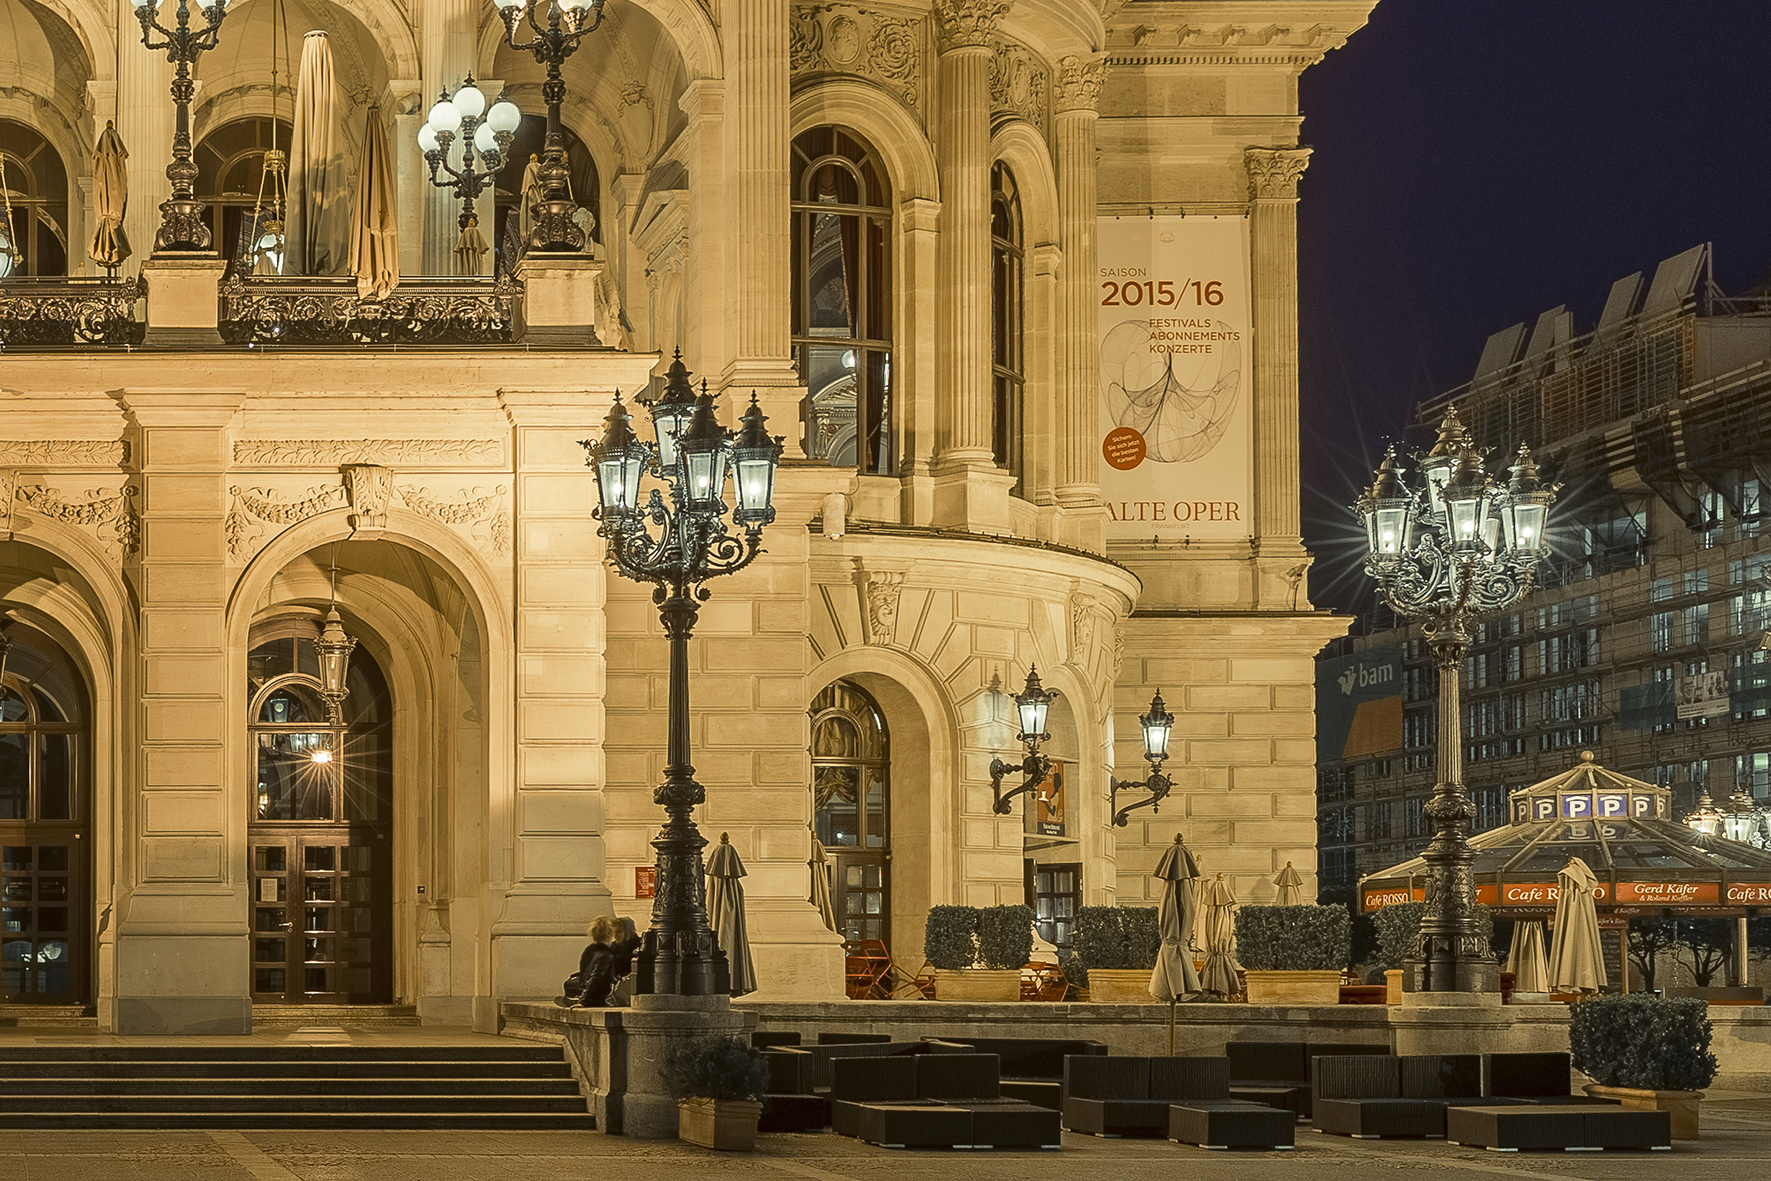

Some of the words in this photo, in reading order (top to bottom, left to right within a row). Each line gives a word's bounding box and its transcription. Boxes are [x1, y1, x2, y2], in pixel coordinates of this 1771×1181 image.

[1100, 268, 1147, 277] SAISON
[1100, 278, 1224, 310] 2015/16
[1149, 318, 1211, 328] FESTIVALS
[1149, 331, 1241, 341] ABONNEMENTS
[1149, 344, 1212, 354] KONZERTE
[1173, 501, 1241, 521] OPER
[1359, 663, 1393, 688] bam
[1539, 802, 1553, 819] P
[1569, 800, 1586, 818] P
[1604, 799, 1621, 818] P
[1635, 800, 1649, 818] P
[1507, 888, 1543, 903] Café
[1634, 883, 1664, 894] Gerd
[1666, 883, 1699, 896] Käfer
[1727, 887, 1756, 903] Café
